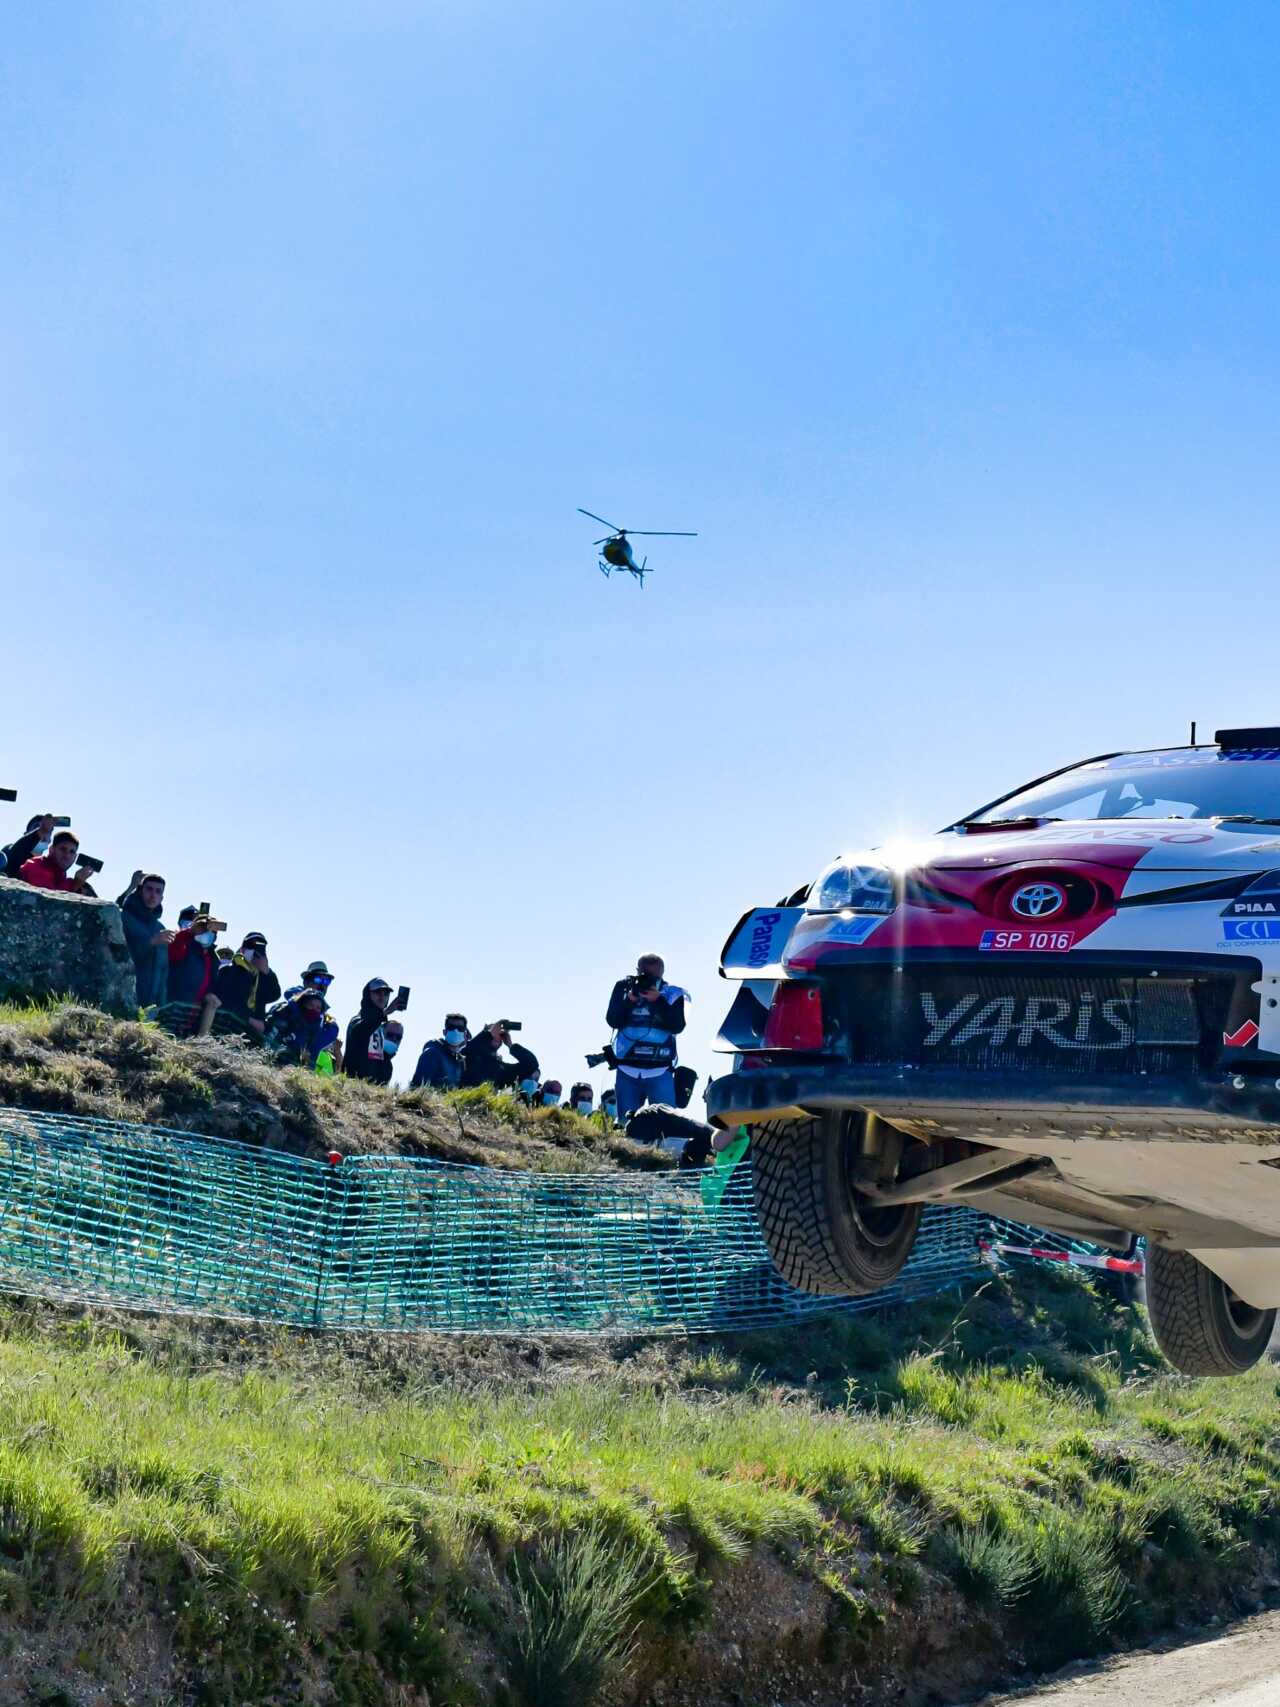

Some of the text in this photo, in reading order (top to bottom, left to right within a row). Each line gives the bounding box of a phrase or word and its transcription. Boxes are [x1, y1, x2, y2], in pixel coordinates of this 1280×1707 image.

[1234, 902, 1276, 913] PIAA
[994, 932, 1070, 949] SP 1016
